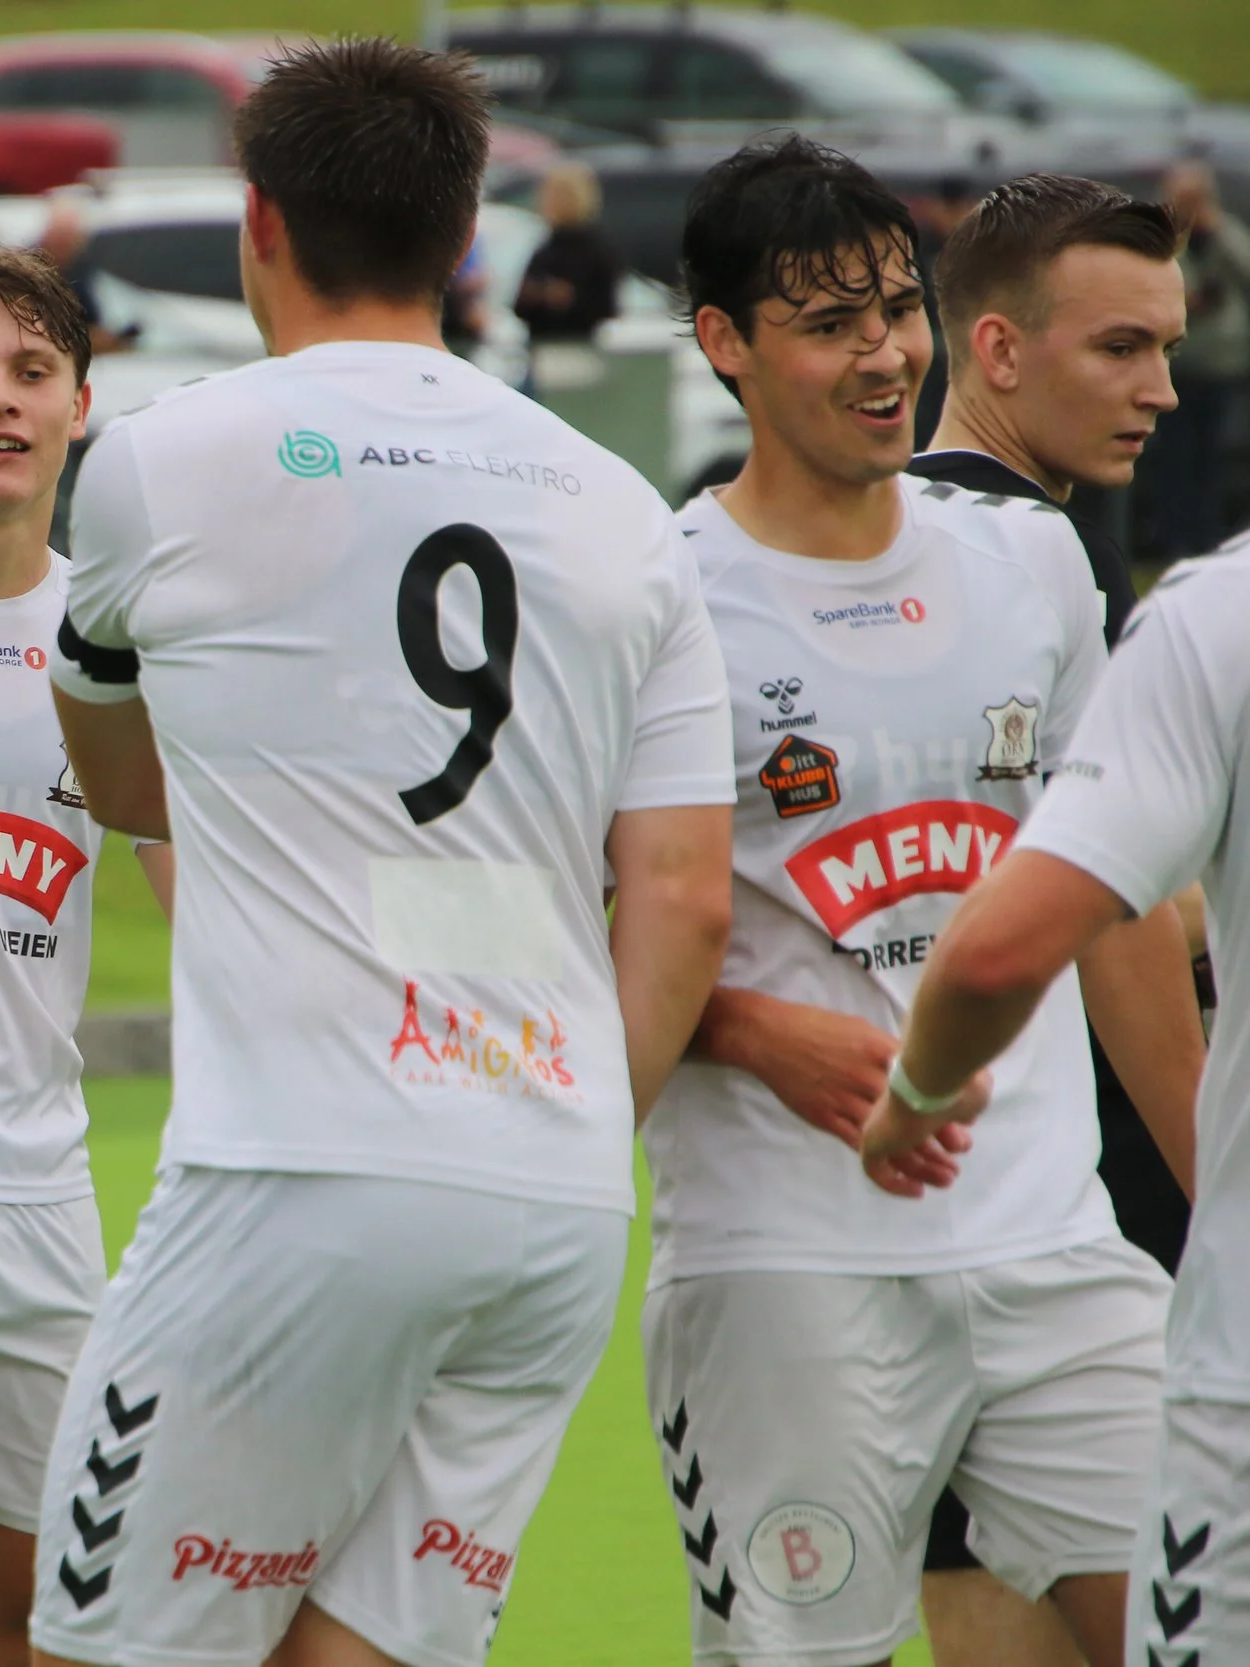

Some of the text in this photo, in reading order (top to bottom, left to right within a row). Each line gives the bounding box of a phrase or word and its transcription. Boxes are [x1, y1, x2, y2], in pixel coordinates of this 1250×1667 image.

[358, 446, 582, 496] ABC ELEKTRO
[813, 600, 897, 625] SpareBank
[397, 522, 519, 825] 9
[761, 710, 817, 733] hummel
[819, 821, 1002, 906] MENY
[780, 1528, 823, 1582] B
